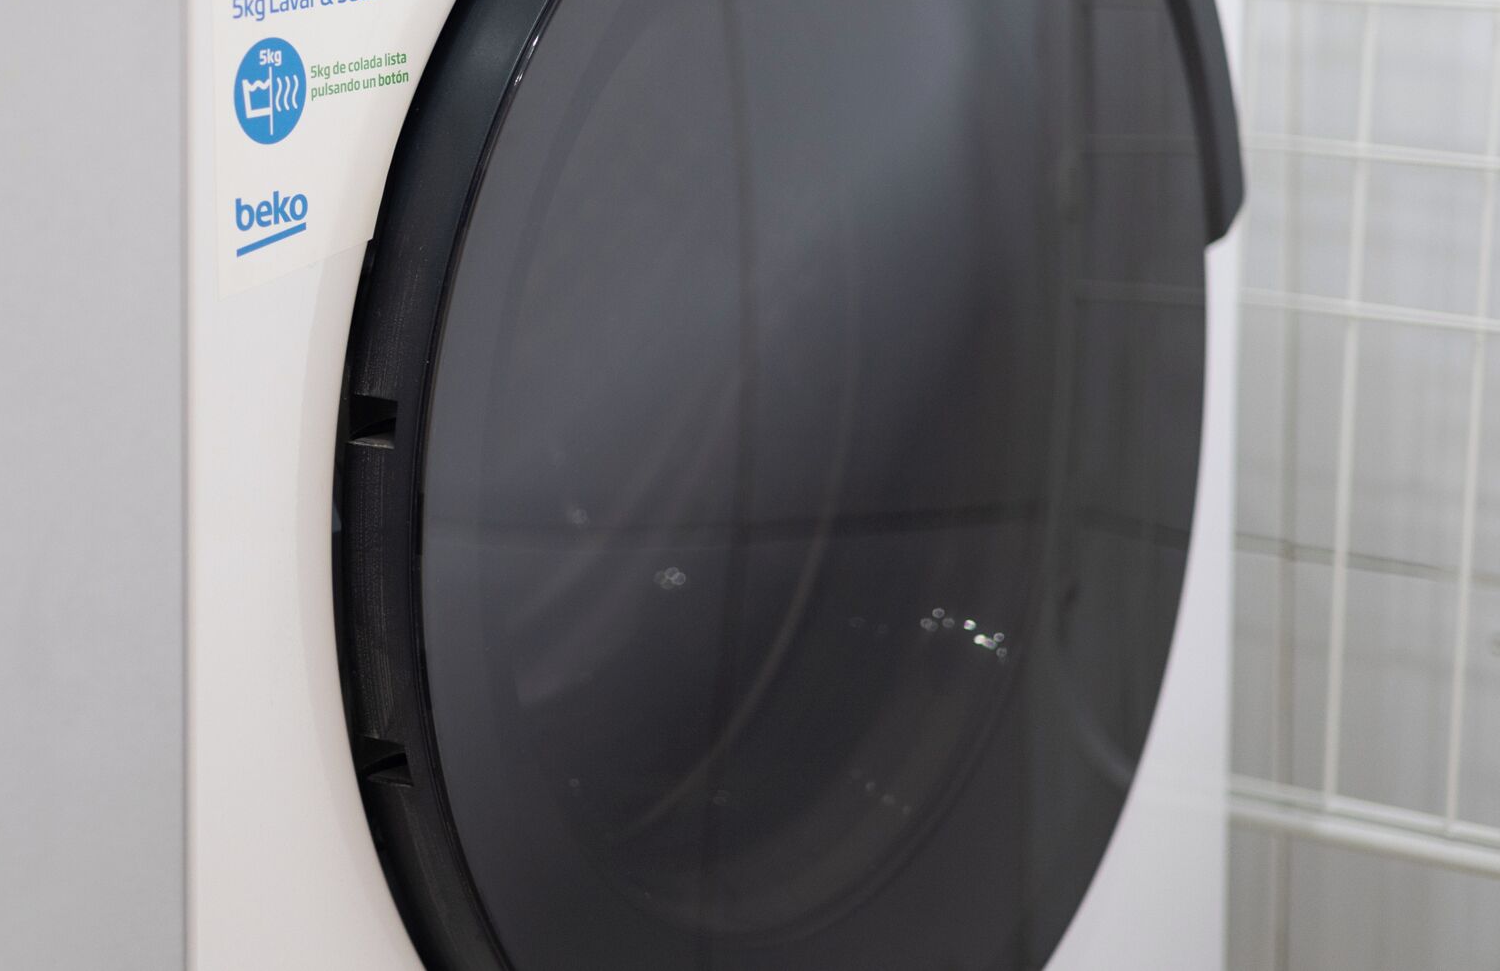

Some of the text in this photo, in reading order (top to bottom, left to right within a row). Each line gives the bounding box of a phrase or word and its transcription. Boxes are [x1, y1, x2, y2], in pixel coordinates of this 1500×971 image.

[259, 48, 282, 66] 5kg
[310, 51, 407, 80] 5kg de colada lista
[310, 71, 409, 101] pulsando un botón
[235, 190, 309, 231] beko
